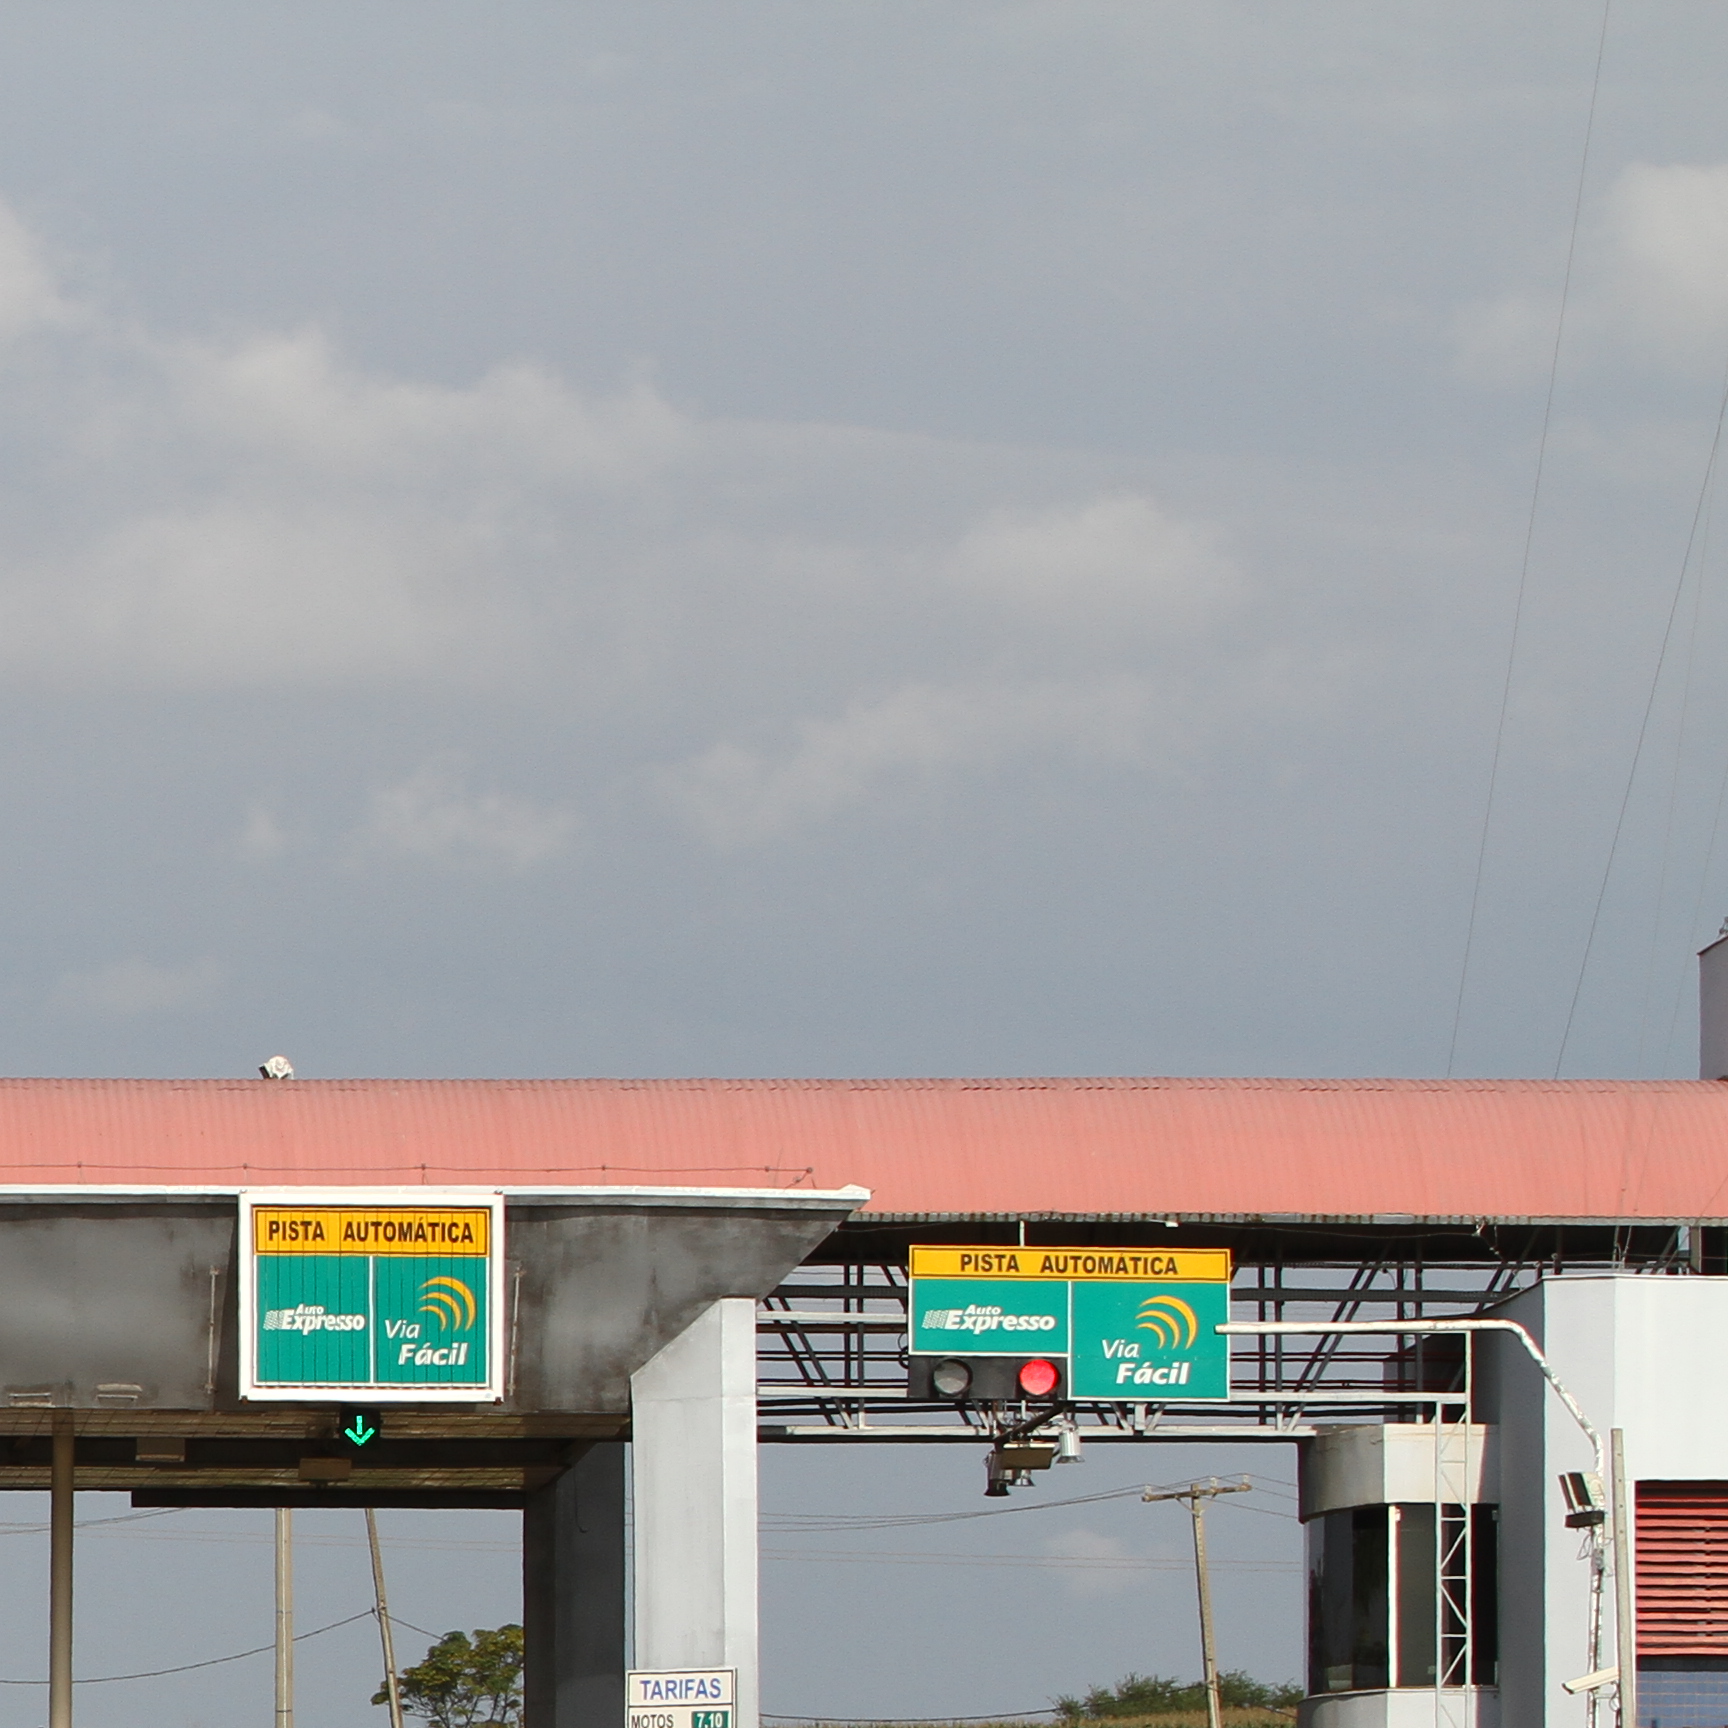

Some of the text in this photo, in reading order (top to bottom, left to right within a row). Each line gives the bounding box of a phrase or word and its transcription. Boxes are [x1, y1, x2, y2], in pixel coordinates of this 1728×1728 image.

[267, 1216, 474, 1244] PISTA AUTOMÁTICA
[960, 1252, 1179, 1276] PISTA AUTOMÁTICA
[295, 1303, 325, 1316] Auto
[944, 1308, 1057, 1335] Expresso
[964, 1304, 1001, 1316] Auto
[280, 1308, 366, 1336] Expresso
[384, 1319, 421, 1340] Via
[397, 1341, 469, 1366] Fácil
[1102, 1338, 1140, 1359] Via
[1116, 1361, 1190, 1386] Fácil
[639, 1677, 722, 1701] TARIFAS
